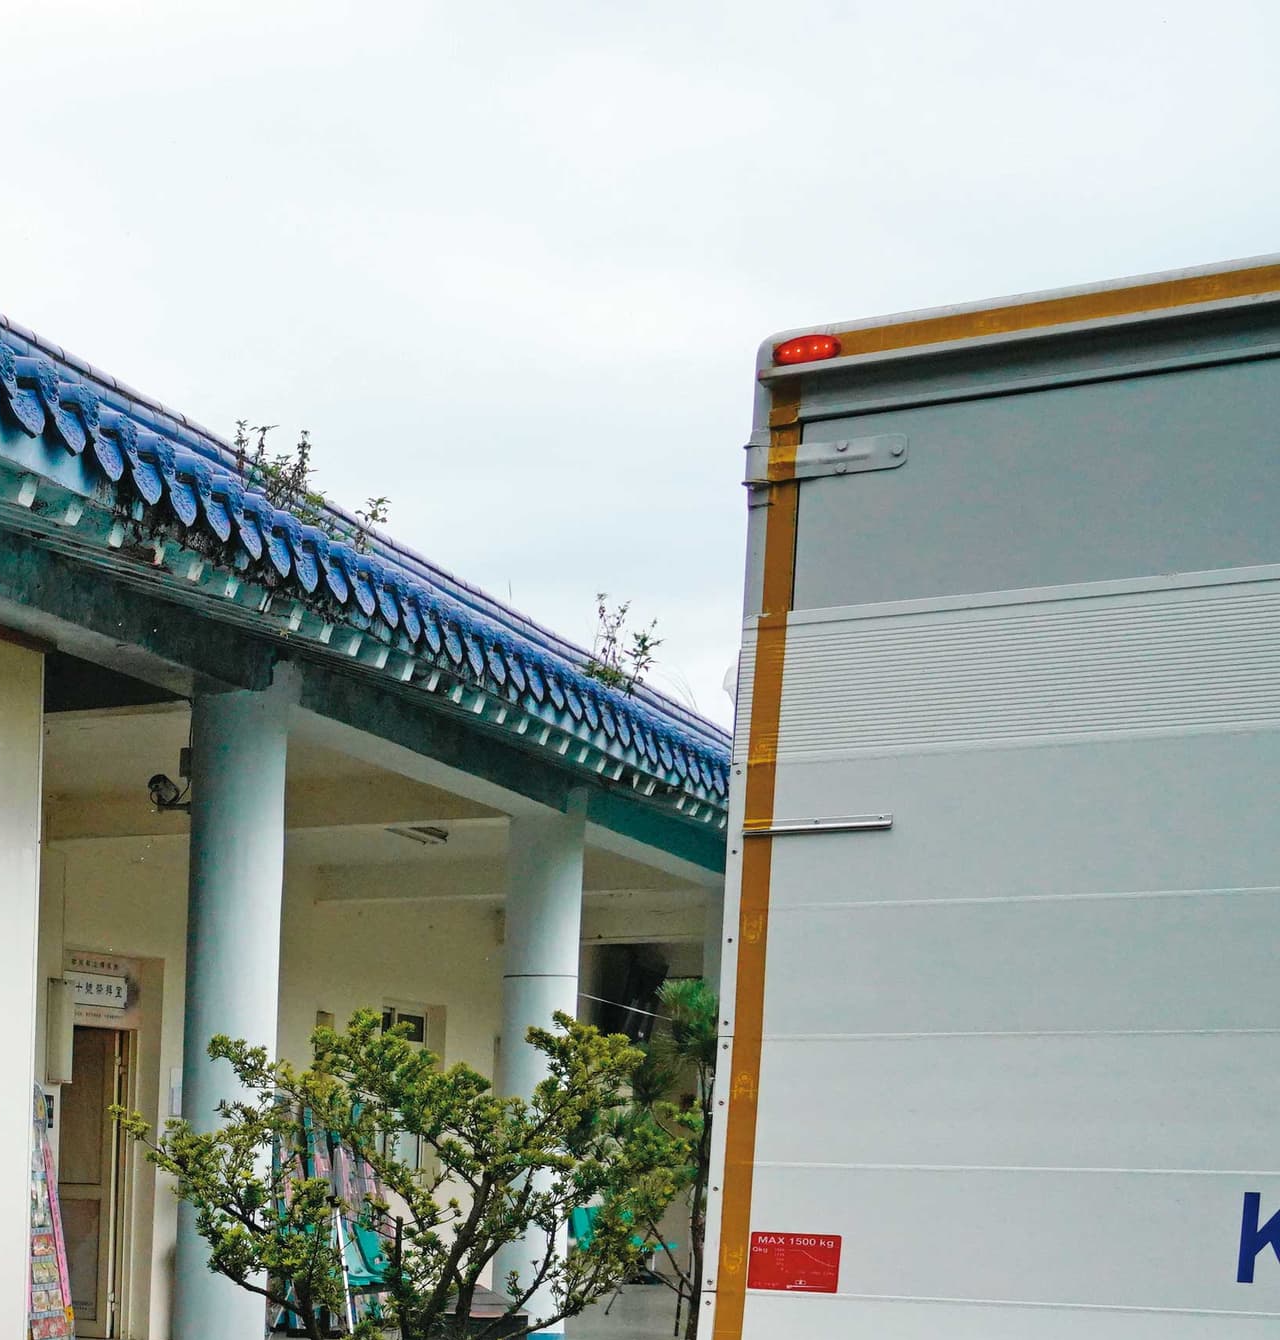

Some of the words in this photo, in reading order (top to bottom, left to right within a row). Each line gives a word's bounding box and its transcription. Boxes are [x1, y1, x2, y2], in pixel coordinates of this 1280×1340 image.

[758, 1236, 785, 1245] MAX
[790, 1238, 816, 1246] 1500
[820, 1240, 834, 1248] kg
